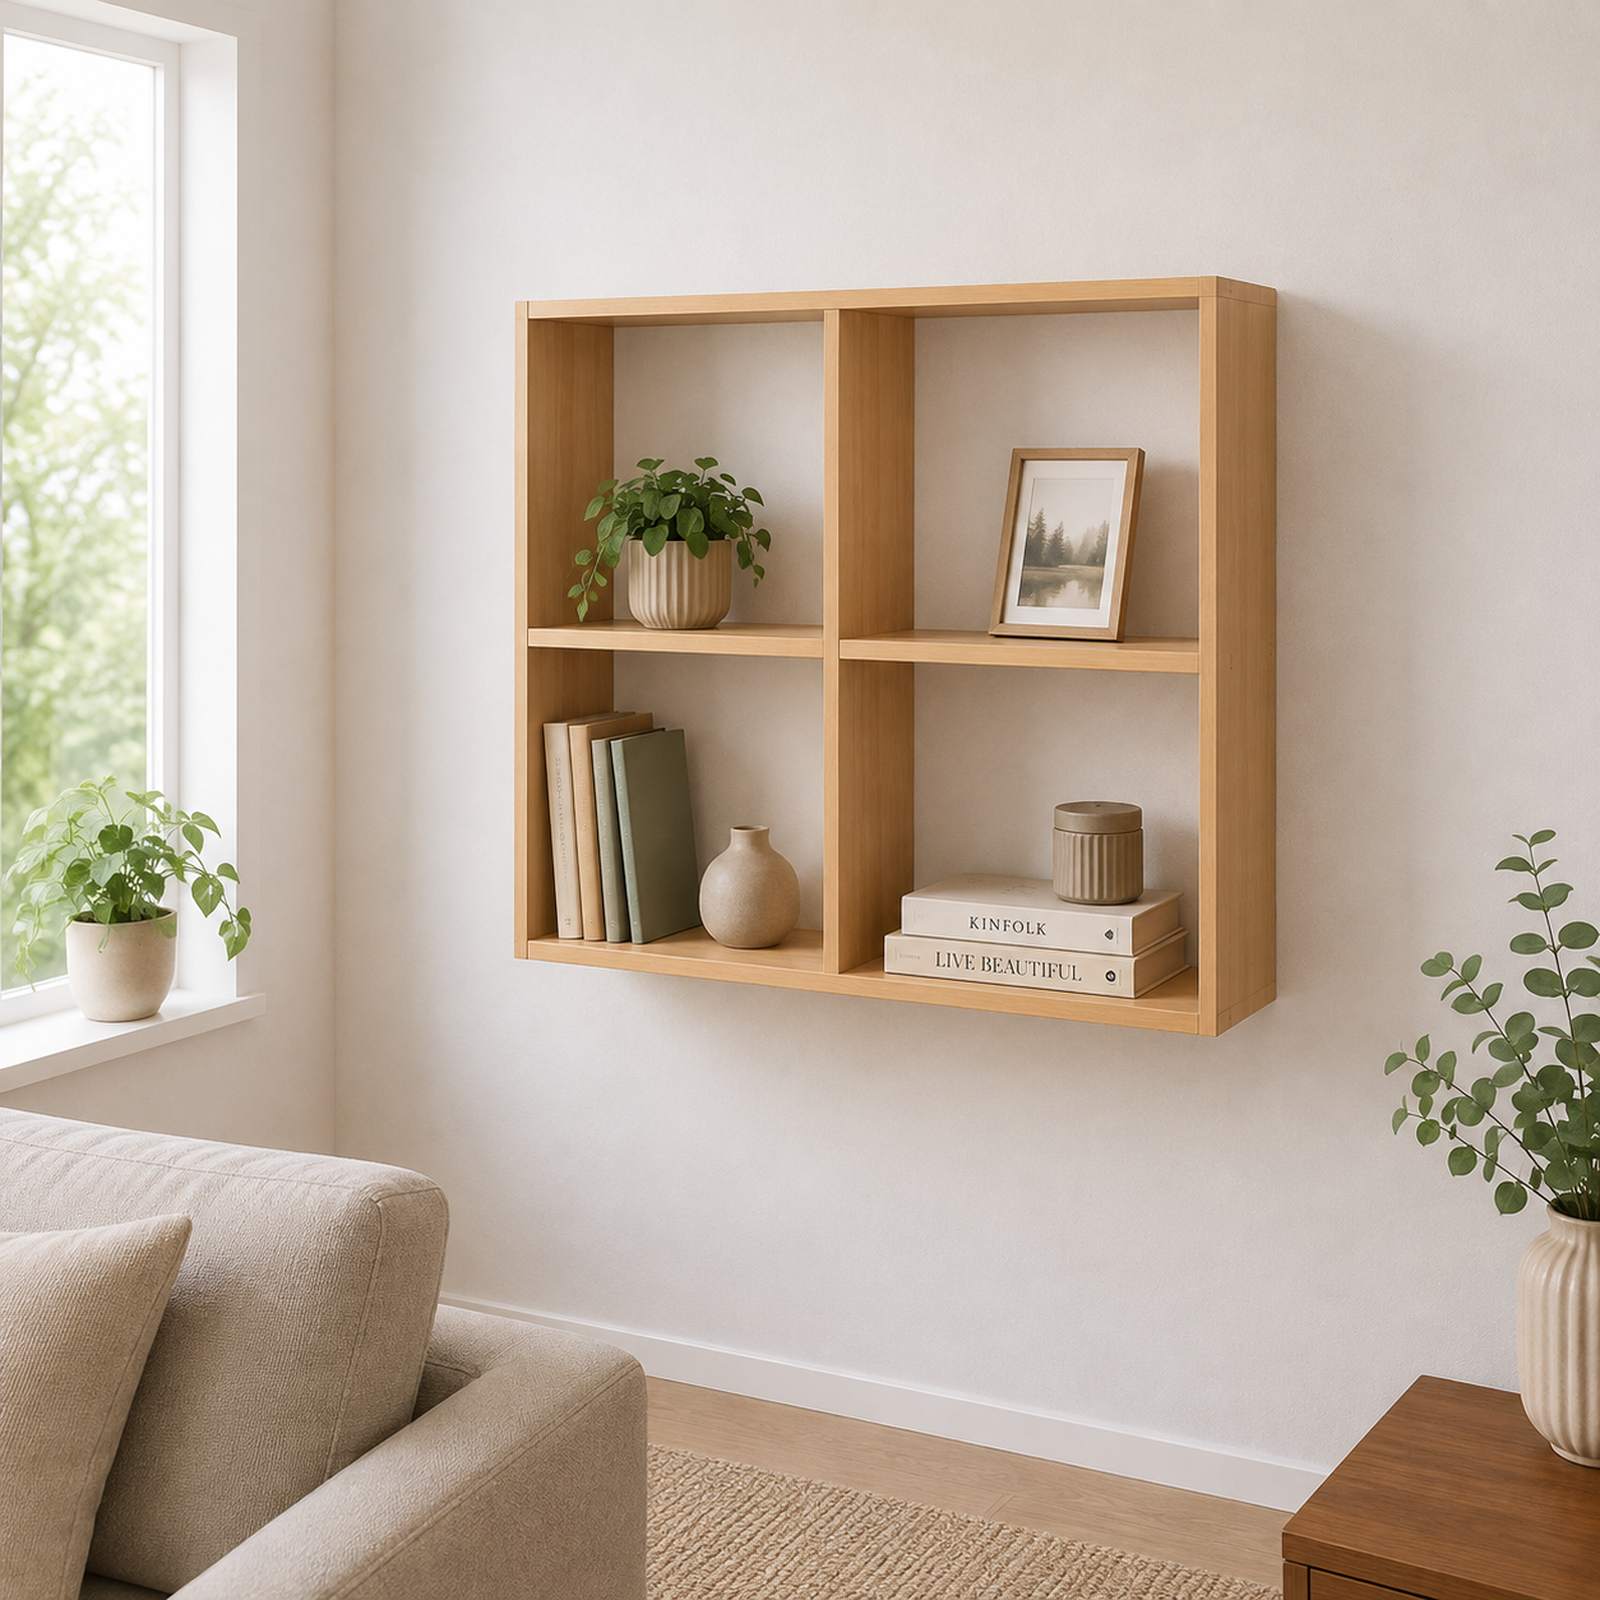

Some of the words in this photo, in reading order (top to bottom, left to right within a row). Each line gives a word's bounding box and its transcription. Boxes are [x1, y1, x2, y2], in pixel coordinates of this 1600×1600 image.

[969, 916, 1047, 936] KINFOLK
[935, 951, 976, 971] LIVE
[981, 956, 1082, 982] BEAUTIFUL
